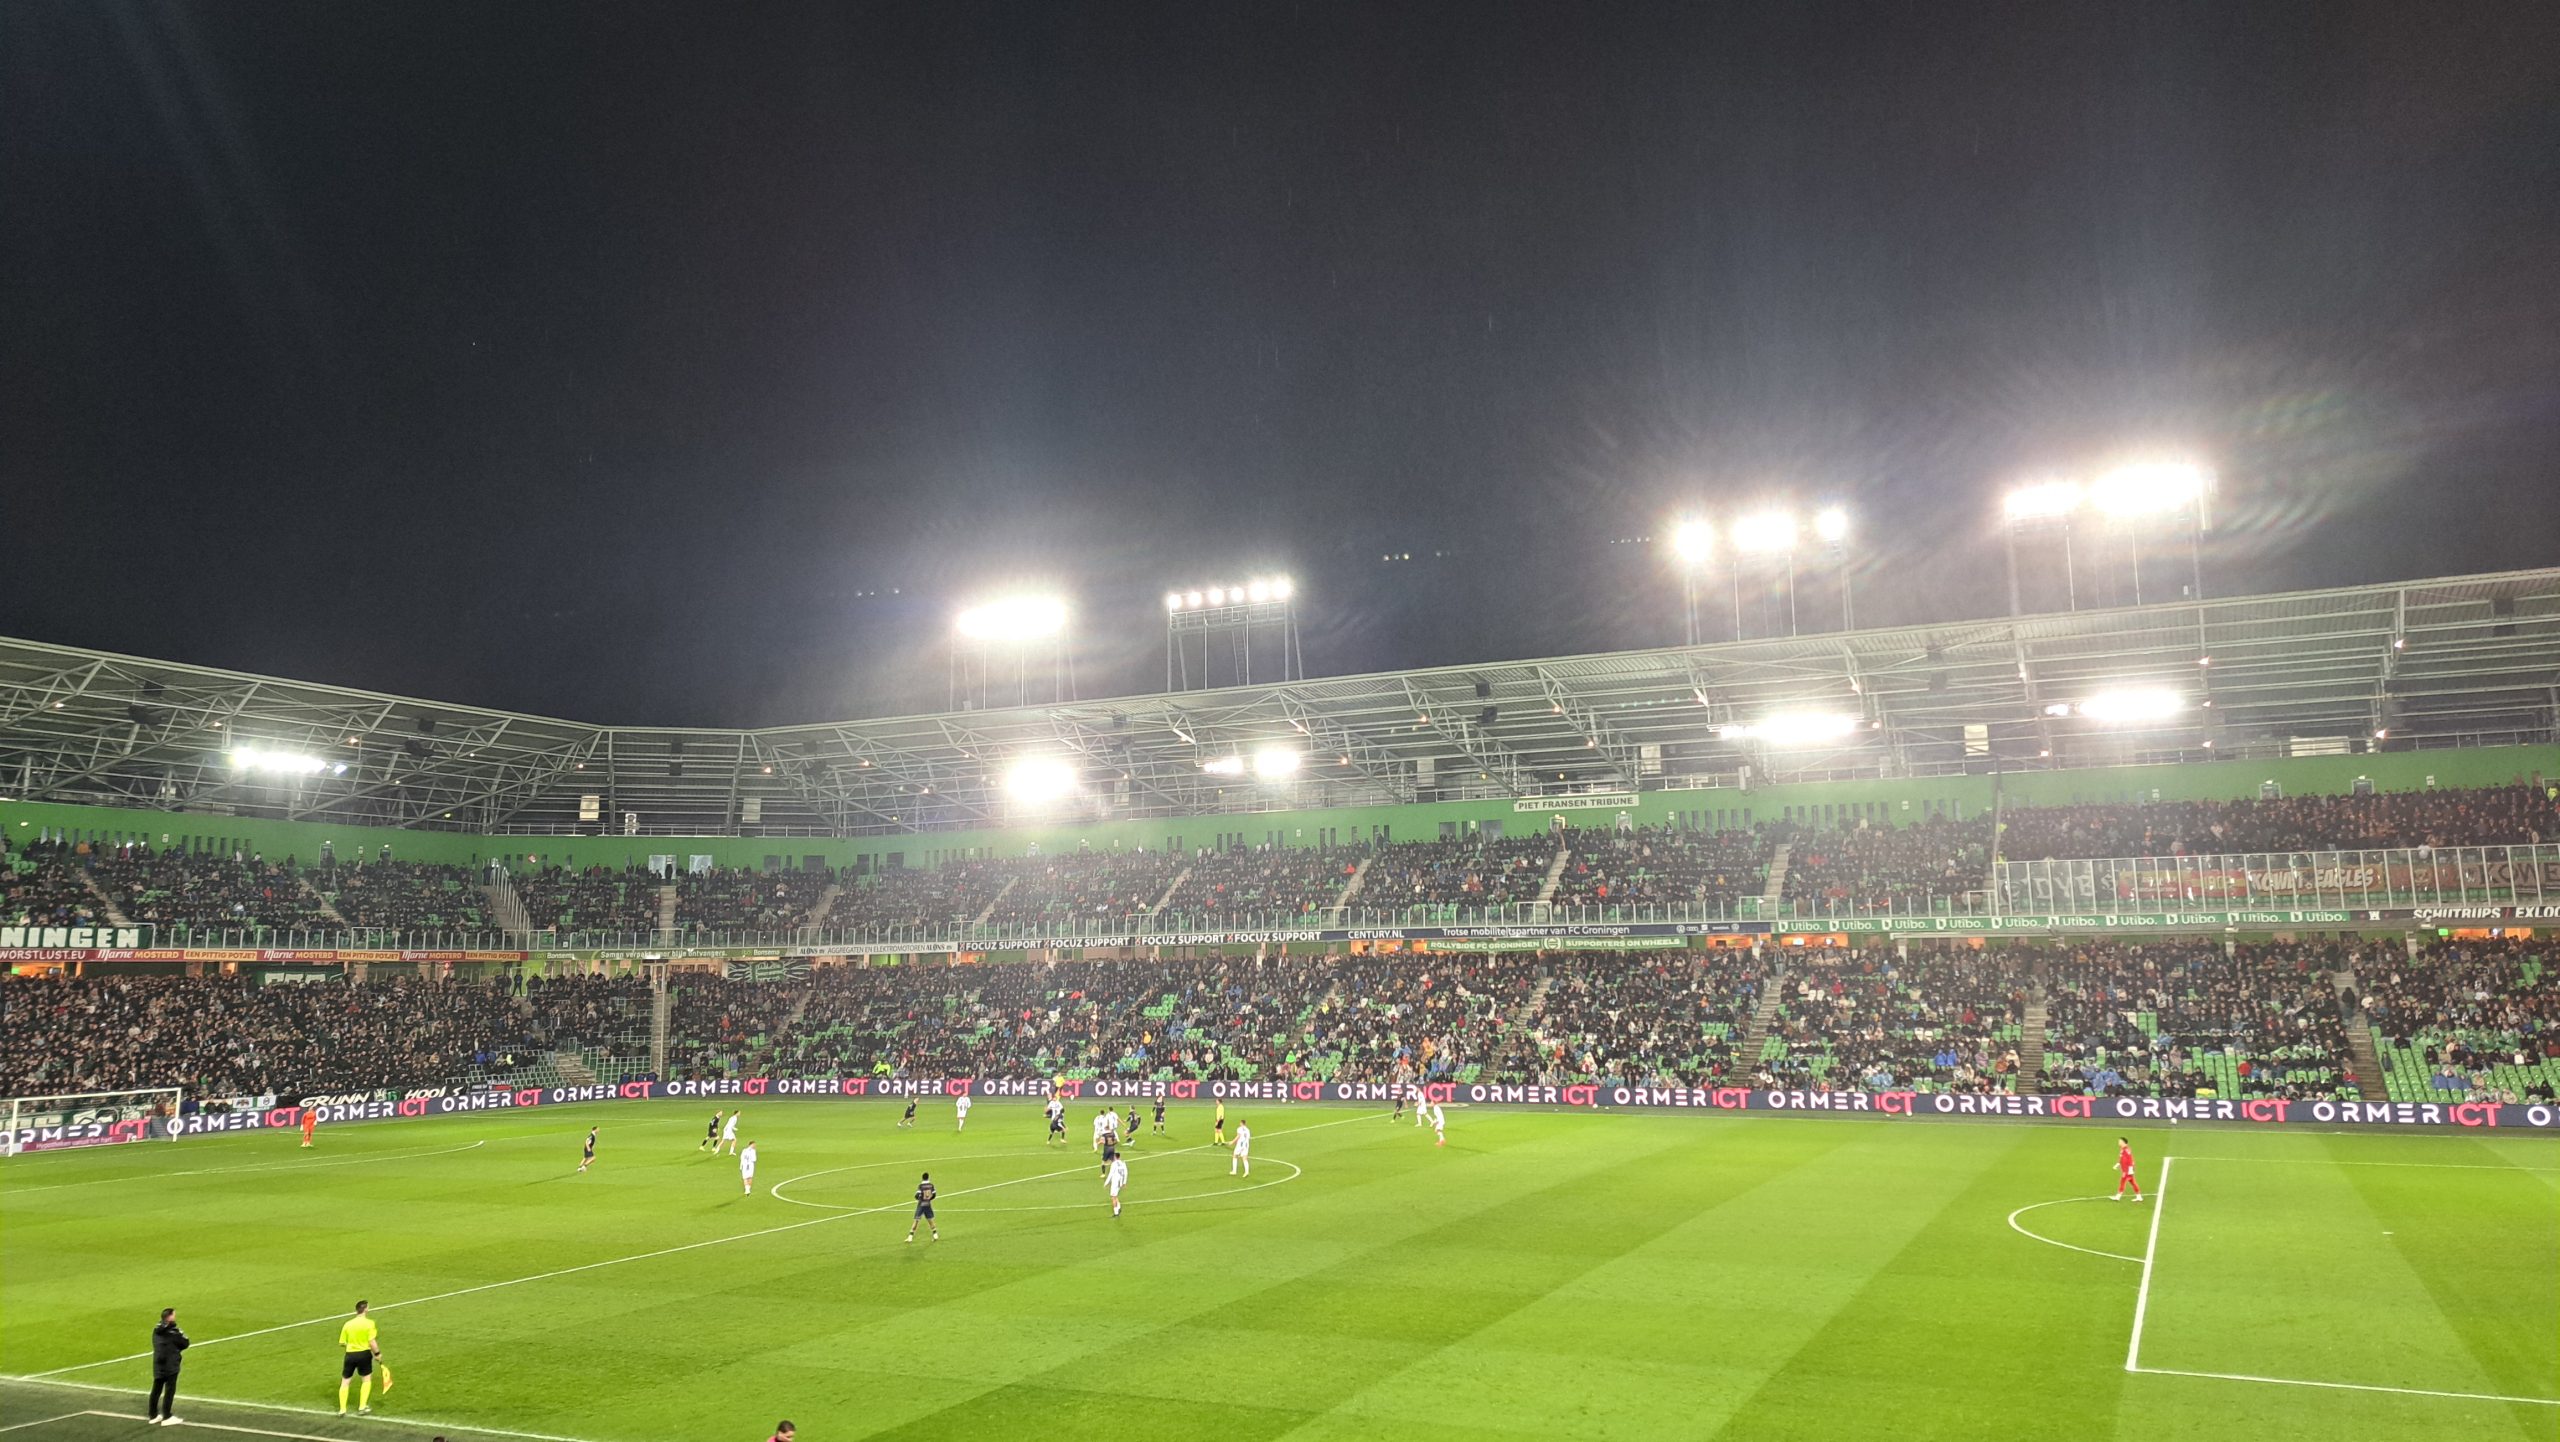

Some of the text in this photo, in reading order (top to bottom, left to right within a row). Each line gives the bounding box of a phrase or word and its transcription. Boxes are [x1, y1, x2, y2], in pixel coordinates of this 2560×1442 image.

[1518, 797, 1634, 810] PIET FRANSEN TRIBUNE
[2316, 868, 2374, 889] EAGLES
[1, 927, 139, 948] NINGEN
[1142, 934, 1225, 945] FOCUZ SUPPORT
[1234, 931, 1321, 942] FOCUZ SUPPORT
[1348, 930, 1404, 939] CENTURY.NL
[1442, 927, 1468, 936] Trotse
[1550, 927, 1566, 935] van
[1568, 926, 1580, 935] FC
[1582, 925, 1630, 936] Groningen
[965, 940, 1042, 950] FOCUZ SUPPORT
[1050, 937, 1130, 948] FOCUZ SUPPORT
[1489, 941, 1540, 949] GRONINGEN
[1565, 939, 1625, 947] SUPPORTERS
[1641, 938, 1681, 946] WHEELS
[0, 950, 86, 960] WORSTLUST.EU
[134, 951, 179, 959] MOSTERD
[553, 1081, 653, 1103] ORMER ICT
[666, 1078, 769, 1095] ORMER ICT
[778, 1078, 870, 1095] ORMER ICT
[878, 1079, 973, 1096] ORMER ICT
[983, 1080, 1083, 1097] ORMER CT
[1095, 1080, 1200, 1098] ORMER ICT
[1212, 1081, 1325, 1100] ORMER ICT
[1337, 1082, 1457, 1102] ORMER ICT
[1470, 1084, 1599, 1105] ORMER ICT
[299, 1091, 371, 1108] GRUNN
[441, 1088, 543, 1112] ORMER ICT
[1614, 1087, 1751, 1109] ORMER ICT
[1768, 1091, 1917, 1113] ORMER ICT
[1935, 1095, 2096, 1118] ORMER ICT
[316, 1098, 430, 1122] ORMER ICT
[2116, 1098, 2291, 1122] ORMER ICT
[2313, 1102, 2504, 1127] ORMER ICT
[2527, 1106, 2560, 1126] O
[166, 1111, 260, 1135] ORMER
[265, 1107, 300, 1127] ICT
[0, 1124, 103, 1145] ORMER
